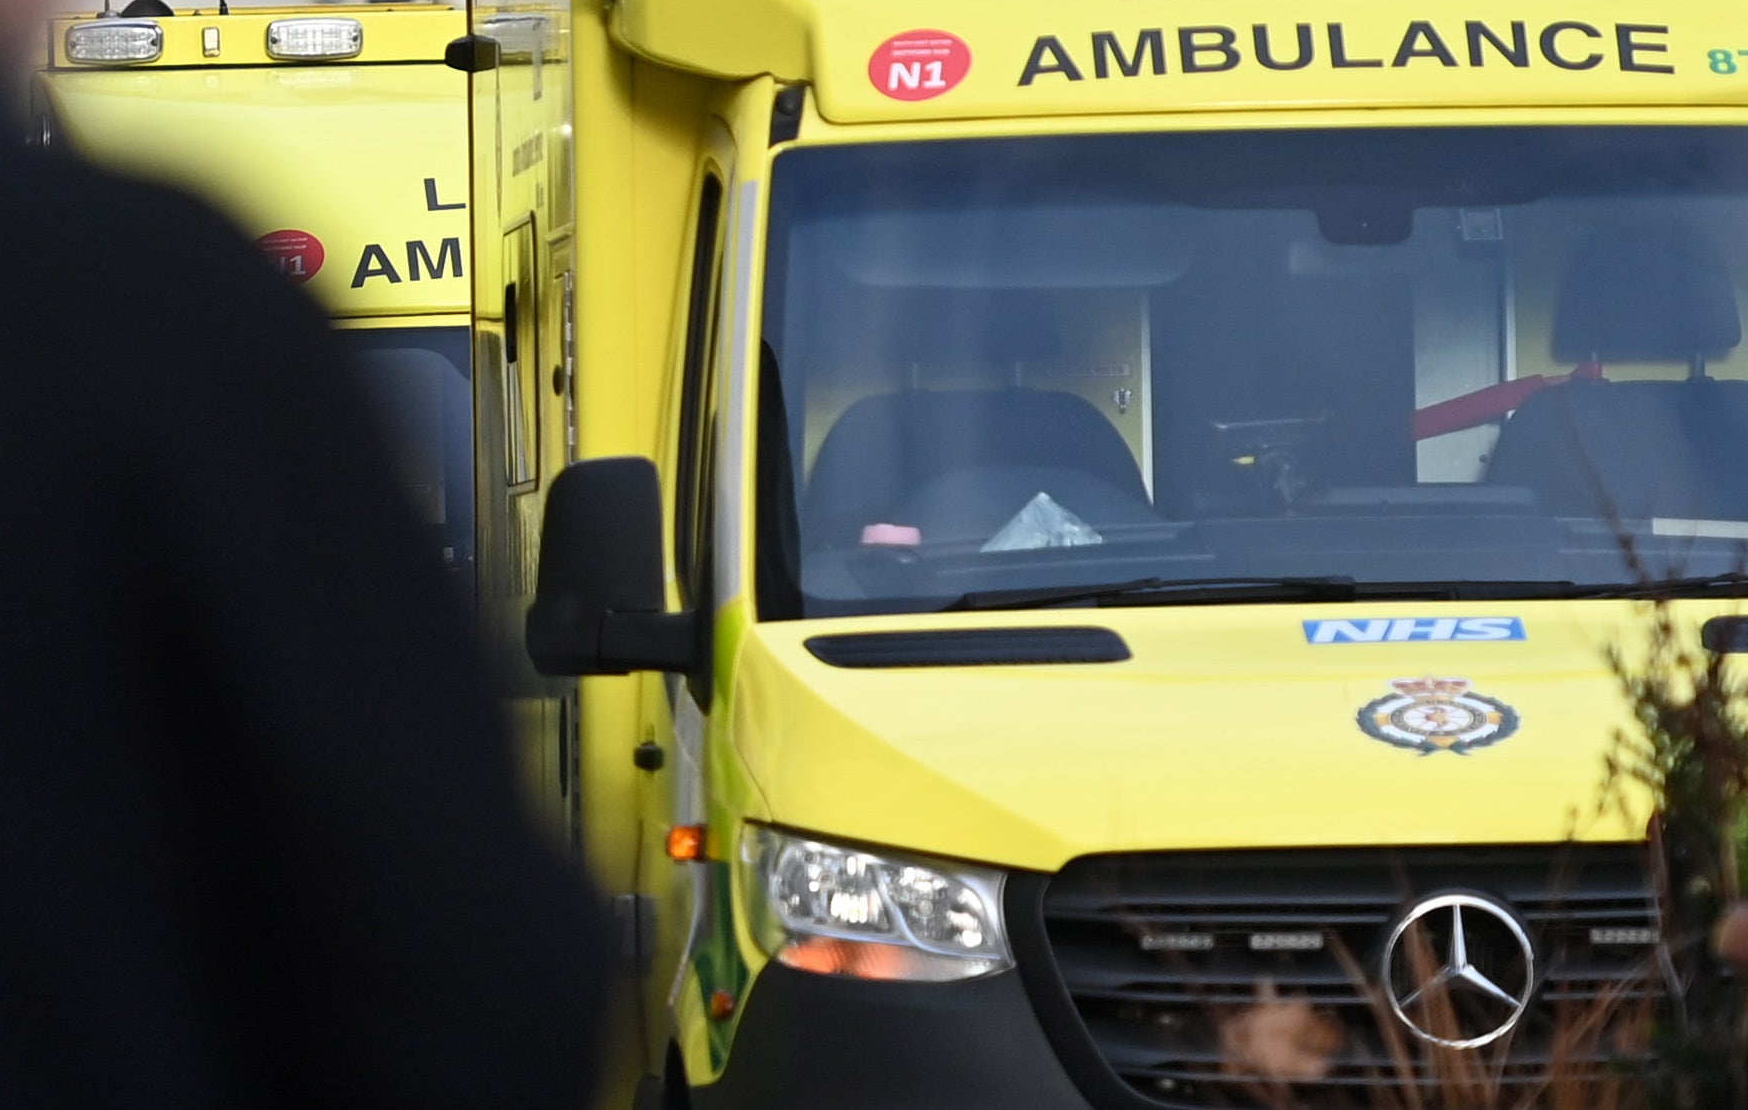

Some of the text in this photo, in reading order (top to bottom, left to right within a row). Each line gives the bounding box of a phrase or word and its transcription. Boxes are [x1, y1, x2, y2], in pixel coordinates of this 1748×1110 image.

[1016, 19, 1676, 88] AMBULANCE
[1707, 48, 1748, 75] 8
[888, 60, 947, 92] N1
[1310, 617, 1516, 644] NHS
